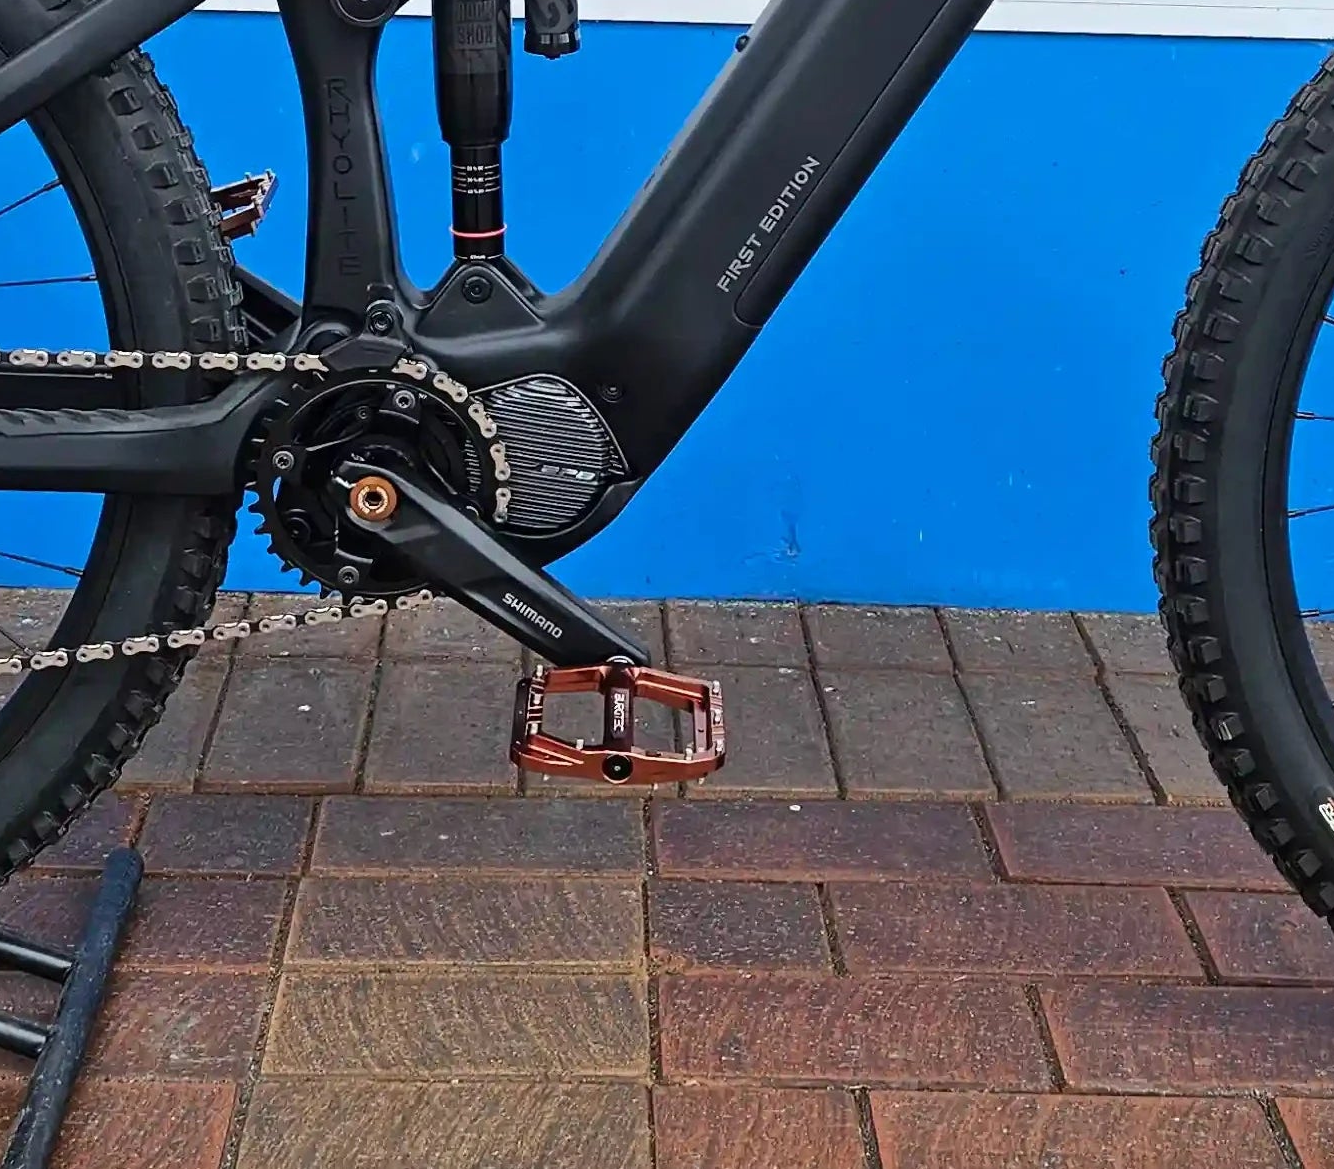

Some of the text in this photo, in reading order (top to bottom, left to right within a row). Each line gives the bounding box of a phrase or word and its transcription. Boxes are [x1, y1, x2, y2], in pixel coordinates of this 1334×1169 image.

[325, 78, 362, 277] RHYOLITE
[716, 155, 821, 293] FIRST EDITION
[502, 592, 563, 639] SHIMANO
